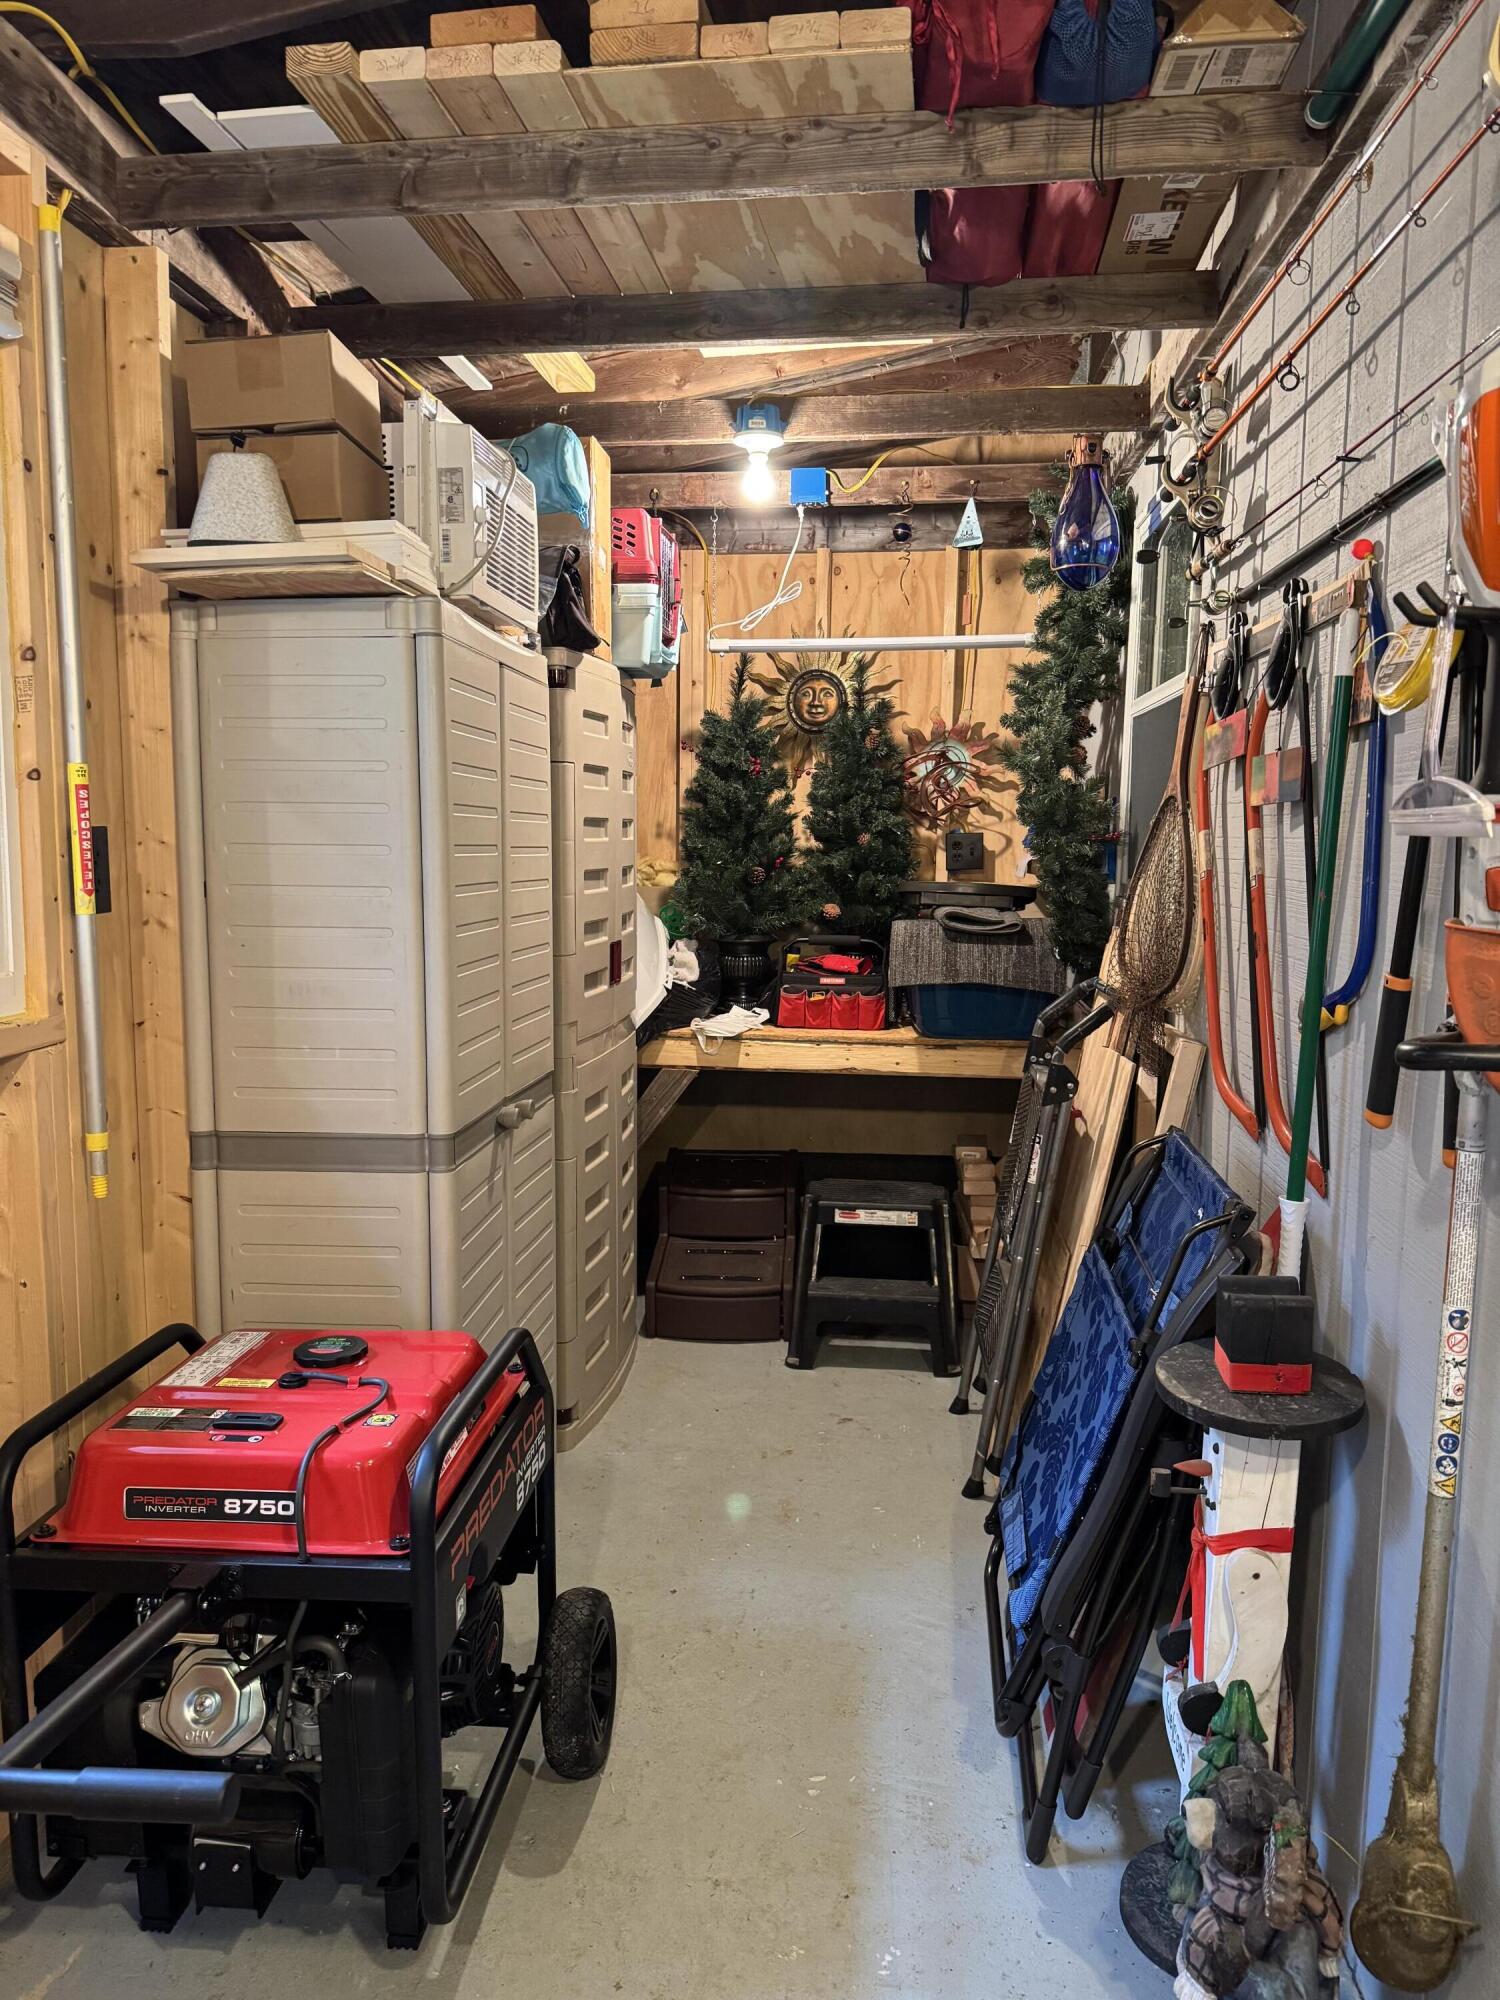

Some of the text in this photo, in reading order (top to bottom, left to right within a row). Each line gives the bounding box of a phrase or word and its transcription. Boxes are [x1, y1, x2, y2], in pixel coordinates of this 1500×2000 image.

[79, 789, 93, 891] TELESCOPES
[516, 1424, 547, 1481] INVERTER
[450, 1396, 546, 1582] PREDATOR
[516, 1441, 547, 1512] 8750
[133, 1495, 218, 1506] PREDATOR
[144, 1505, 207, 1514] INVERTER
[224, 1498, 295, 1516] 8750
[184, 1729, 215, 1745] OHV
